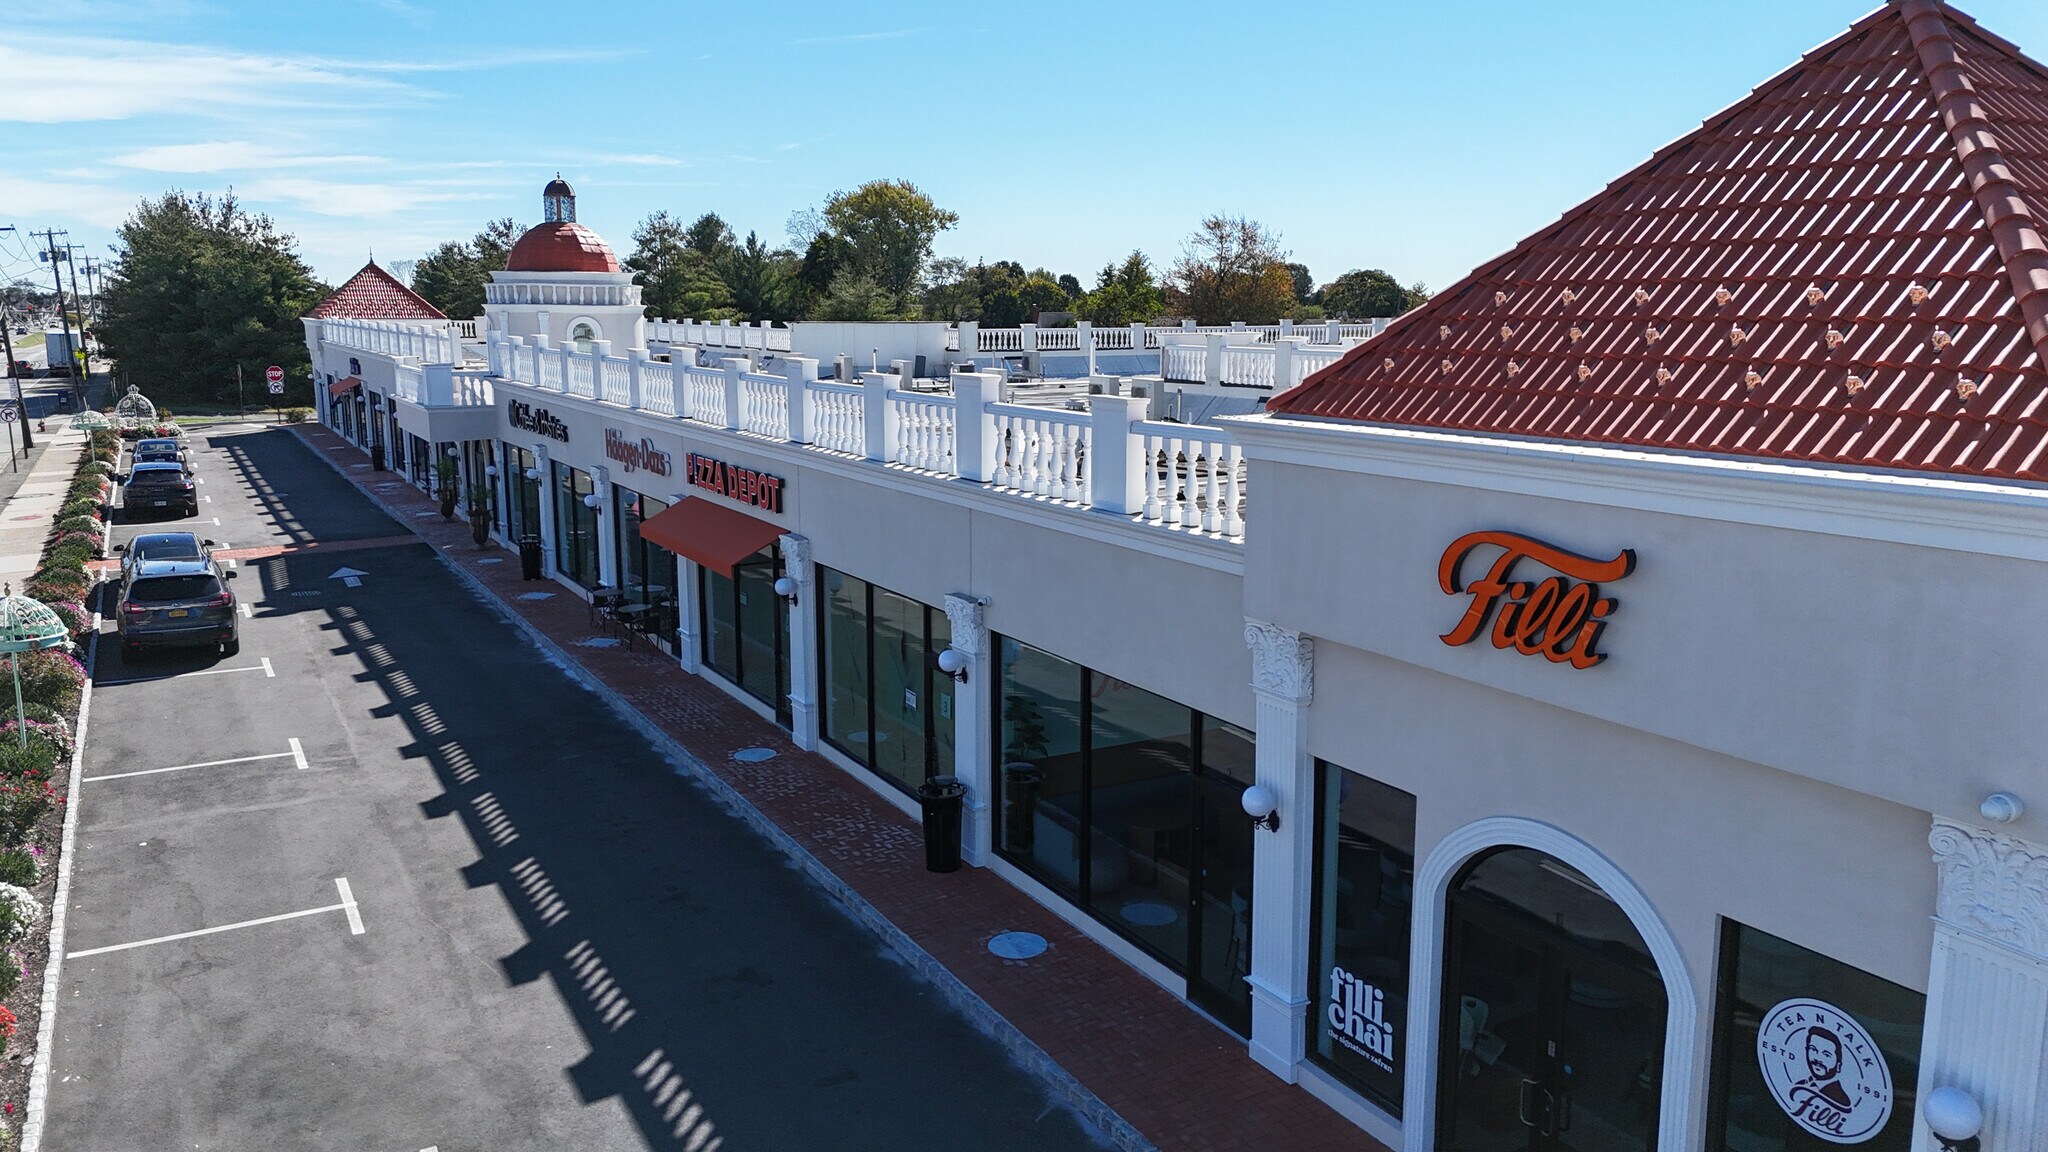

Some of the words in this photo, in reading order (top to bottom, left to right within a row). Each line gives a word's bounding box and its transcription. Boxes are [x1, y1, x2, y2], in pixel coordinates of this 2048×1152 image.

[686, 452, 726, 497] PIZZA
[727, 465, 783, 514] DEPOT
[1438, 530, 1637, 670] Filli
[1330, 966, 1384, 1027] filli
[1327, 1029, 1339, 1040] the
[1328, 1000, 1394, 1061] chai
[1762, 1041, 1796, 1061] ESTD
[1776, 1012, 1806, 1033] TEA
[1815, 1013, 1825, 1024] N
[1836, 1022, 1875, 1069] TALK
[1789, 1084, 1853, 1135] Filli
[1857, 1083, 1888, 1103] 1991
